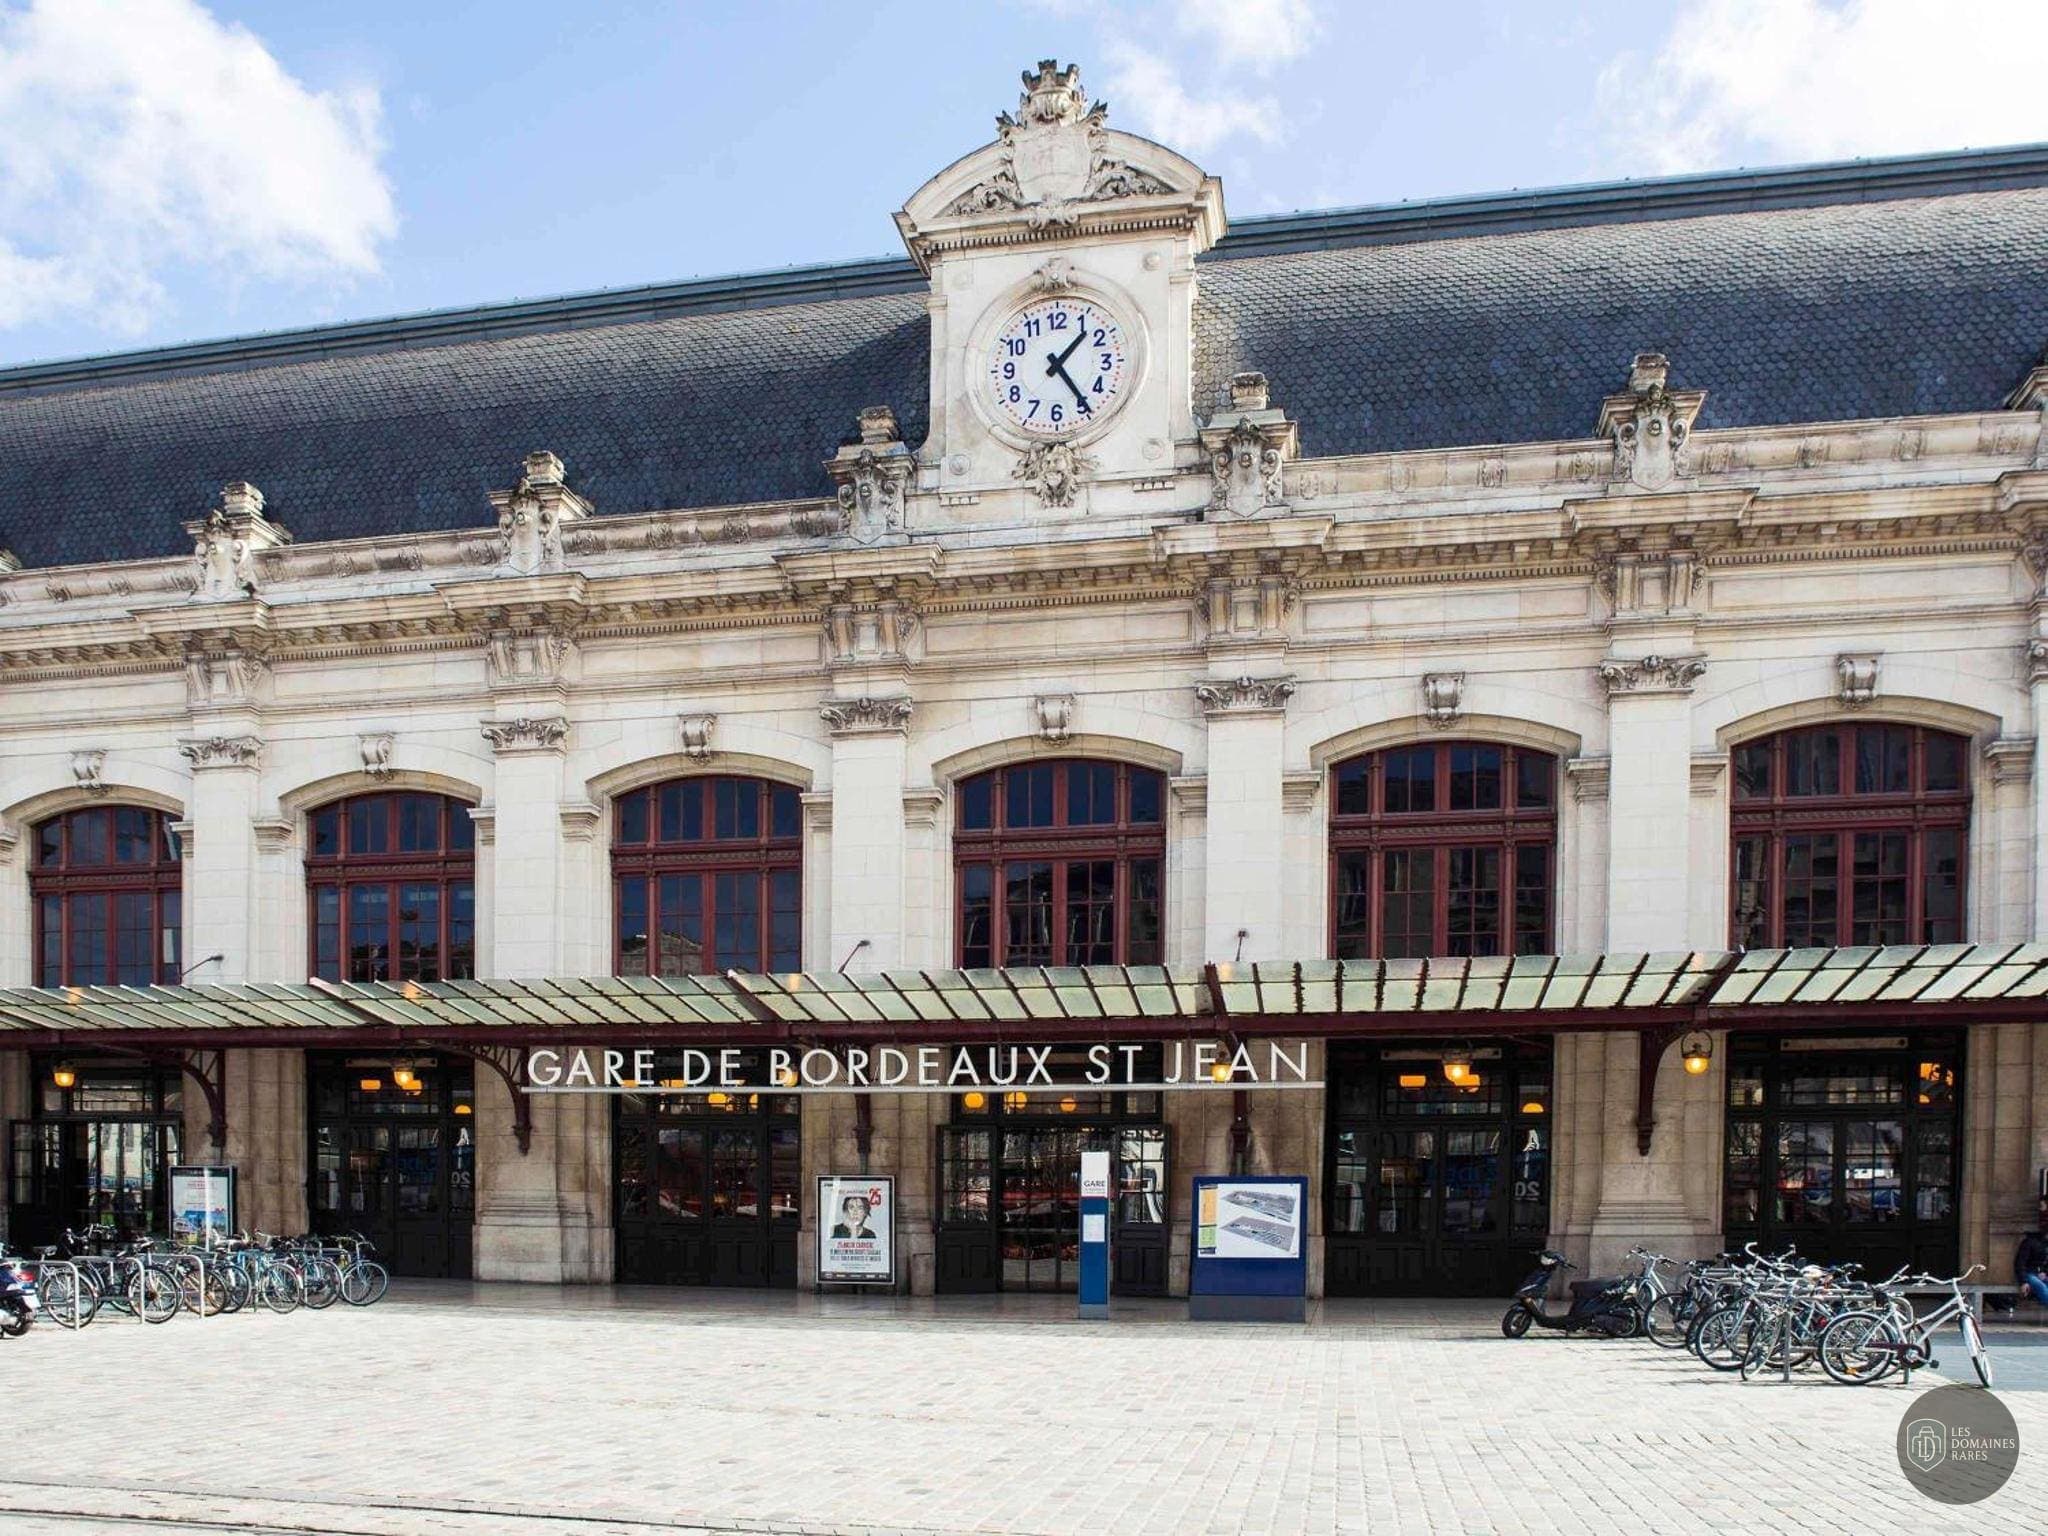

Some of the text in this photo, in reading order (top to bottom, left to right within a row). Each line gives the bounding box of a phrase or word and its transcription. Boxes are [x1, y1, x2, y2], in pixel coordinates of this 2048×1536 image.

[1024, 318, 1041, 338] 11
[1046, 312, 1067, 331] 12
[1077, 315, 1085, 333] 1
[1093, 329, 1106, 347] 2
[1006, 338, 1026, 357] 10
[1003, 362, 1015, 380] 9
[1100, 353, 1113, 371] 3
[1092, 375, 1104, 394] 4
[1009, 385, 1020, 403] 8
[1028, 400, 1041, 419] 7
[1050, 404, 1063, 422] 6
[1076, 396, 1088, 414] 5
[527, 1042, 1308, 1086] GARE DE BORDEAUX ST JEAN
[869, 1187, 882, 1206] 25
